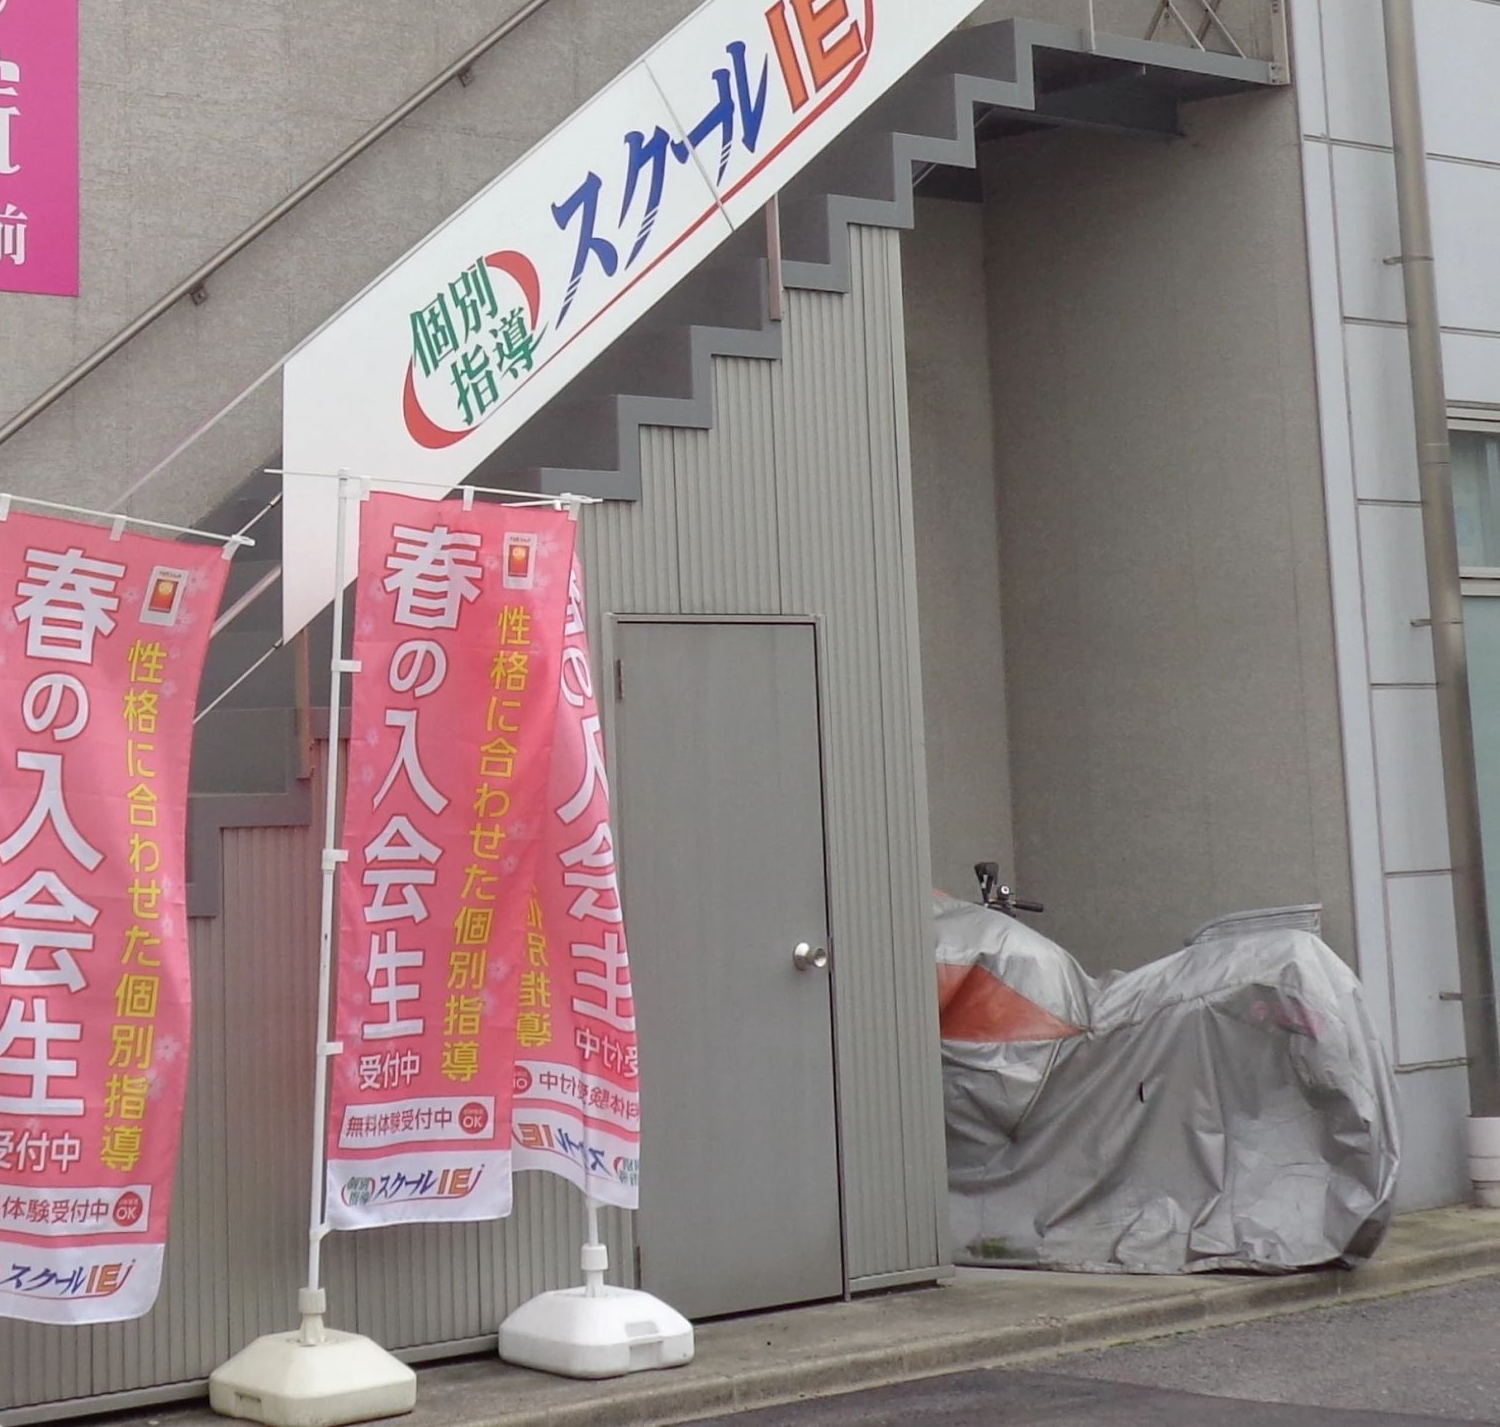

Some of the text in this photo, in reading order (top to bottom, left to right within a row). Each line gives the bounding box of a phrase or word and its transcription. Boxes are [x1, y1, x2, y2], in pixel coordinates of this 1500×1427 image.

[409, 256, 501, 380] 個別
[449, 307, 548, 426] 指導
[362, 525, 484, 1040] 春の入会生
[441, 605, 532, 1083] 性格に合わせた個別指導
[100, 639, 167, 1172] 性格に合わせた個別指導
[358, 1049, 420, 1091] 受付中
[346, 1107, 452, 1138] 無料体験受付中
[462, 1116, 483, 1128] OK
[116, 1206, 137, 1220] OK
[374, 1167, 472, 1199] スクールIE
